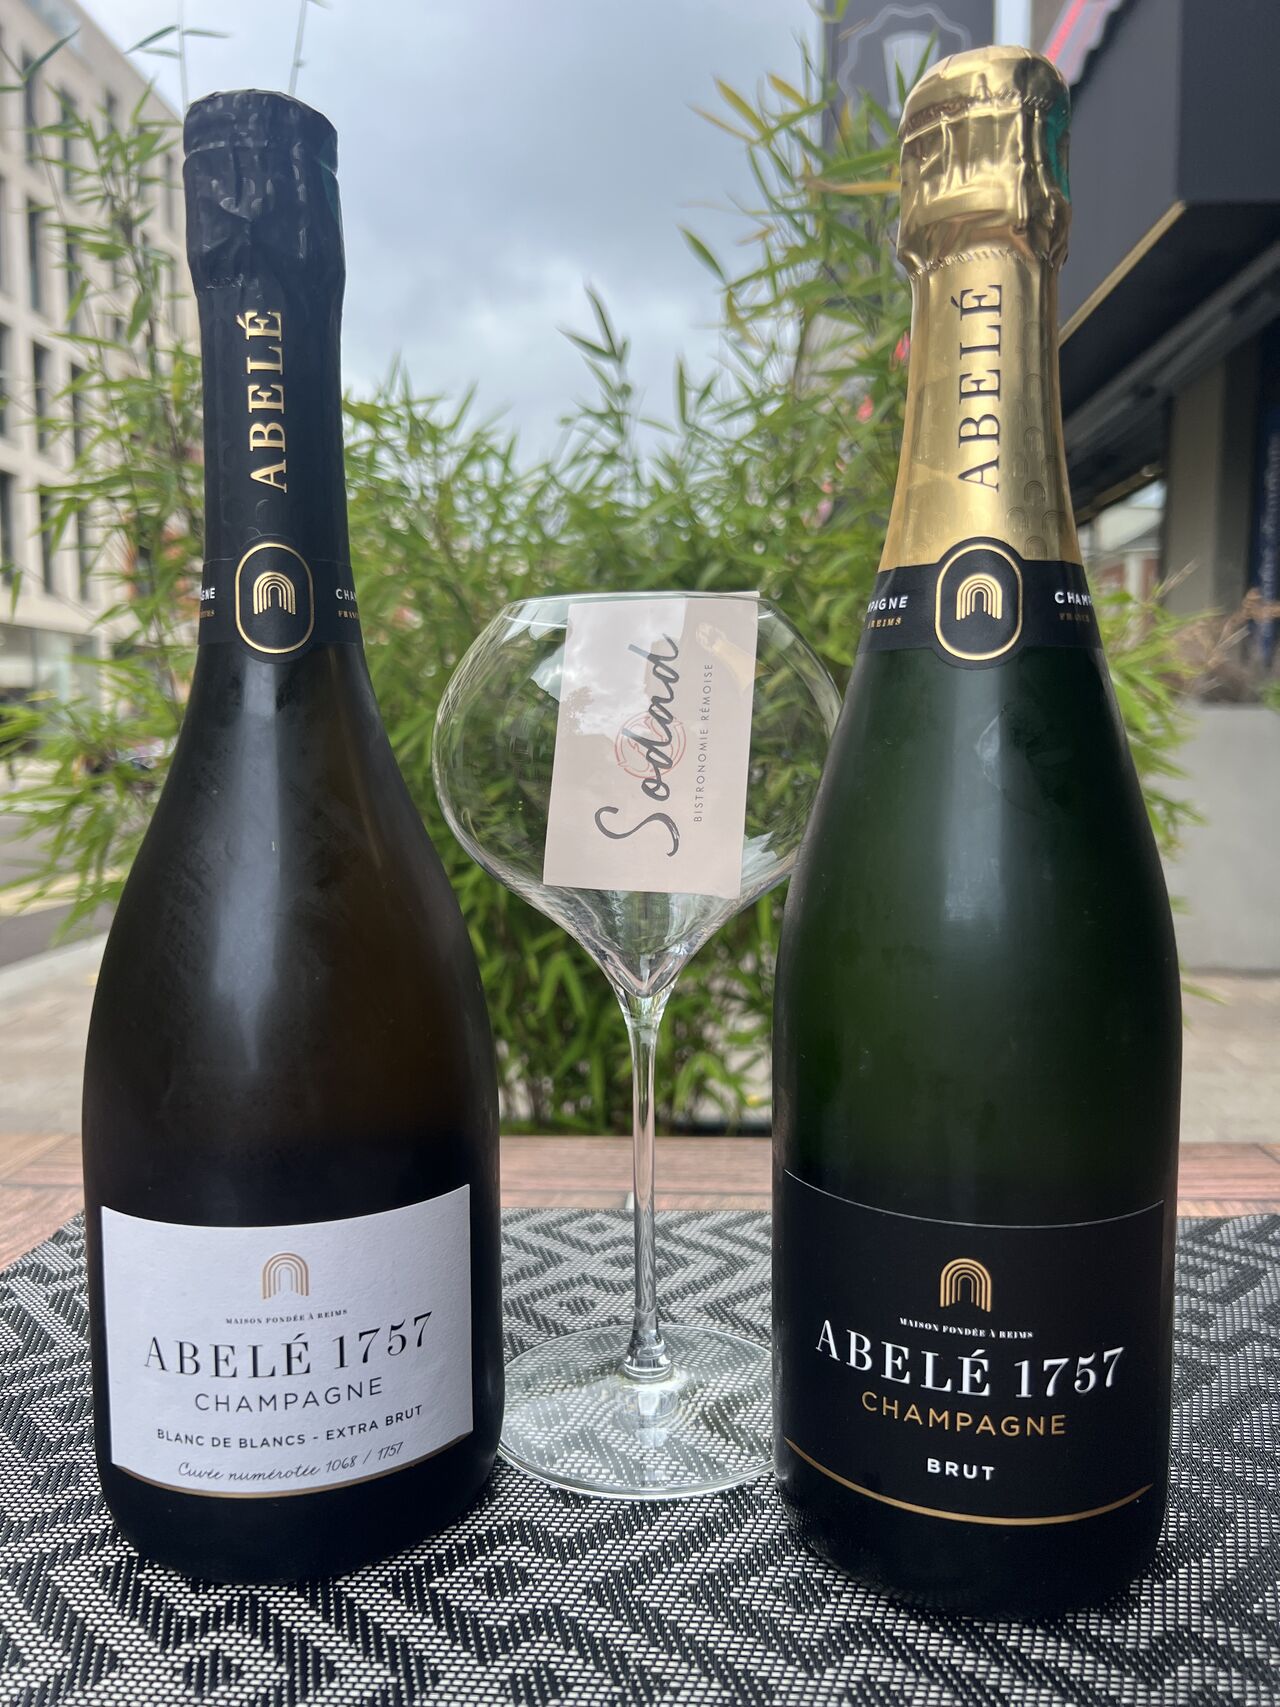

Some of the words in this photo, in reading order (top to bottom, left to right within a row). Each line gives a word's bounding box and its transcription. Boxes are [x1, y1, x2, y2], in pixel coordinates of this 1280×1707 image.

[236, 309, 288, 494] ABELÉ
[951, 283, 1003, 493] ABELÉ
[700, 663, 714, 721] RÉMOISE
[693, 728, 709, 823] BISTRONOMIE
[226, 1317, 262, 1325] MAISON
[266, 1314, 305, 1324] FONDÉE
[318, 1309, 348, 1319] REIMS
[899, 1317, 939, 1332] MAISON
[942, 1325, 986, 1338] FONDÉE
[999, 1330, 1034, 1339] REIMS
[143, 1333, 312, 1378] ABELÉ
[332, 1310, 433, 1370] 1757
[815, 1319, 992, 1397] ABELÉ
[1014, 1346, 1125, 1399] 1757
[194, 1376, 384, 1412] CHAMPAGNE
[861, 1391, 1067, 1437] CHAMPAGNE
[157, 1428, 205, 1447] BLANC
[211, 1436, 232, 1449] DE
[239, 1434, 306, 1449] BLANCS
[326, 1419, 380, 1441] EXTRA
[384, 1404, 424, 1427] BRUT
[178, 1461, 224, 1480] Cuvée
[229, 1464, 321, 1481] numérotée
[326, 1455, 358, 1473] 1068
[377, 1441, 404, 1461] 1757
[926, 1458, 996, 1481] BRUT
